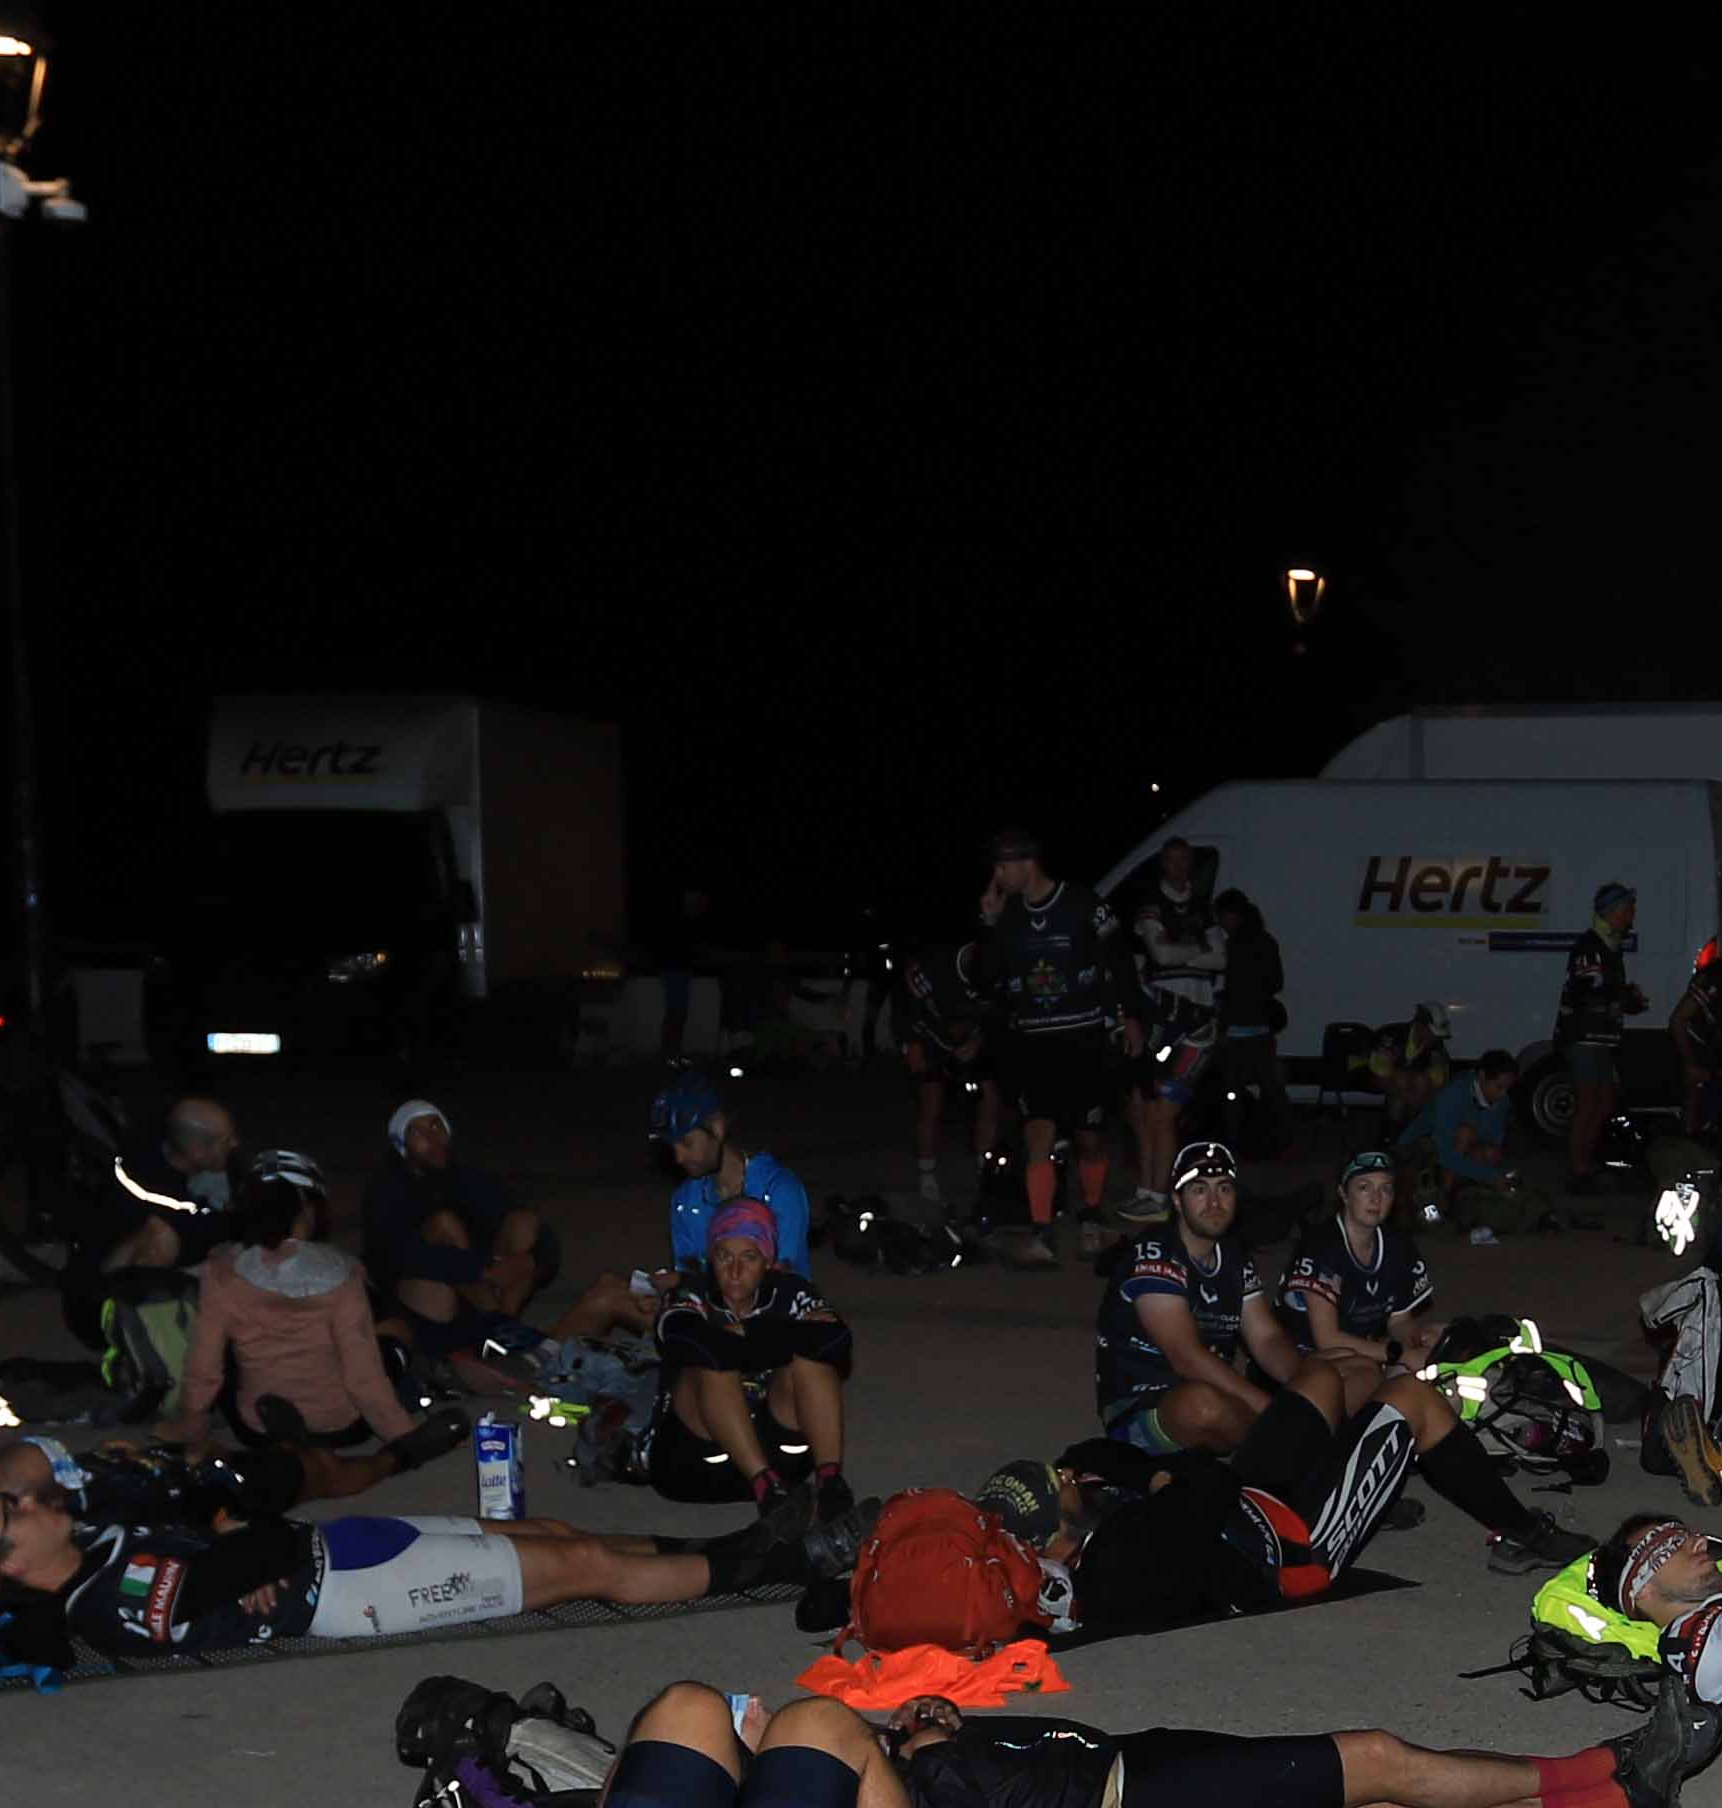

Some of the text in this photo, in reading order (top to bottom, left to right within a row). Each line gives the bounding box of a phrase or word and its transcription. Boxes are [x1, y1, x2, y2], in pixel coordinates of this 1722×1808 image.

[241, 739, 382, 776] Hertz
[1357, 856, 1551, 912] Hertz
[1134, 1241, 1163, 1262] 15
[1327, 1422, 1400, 1562] SCOTT
